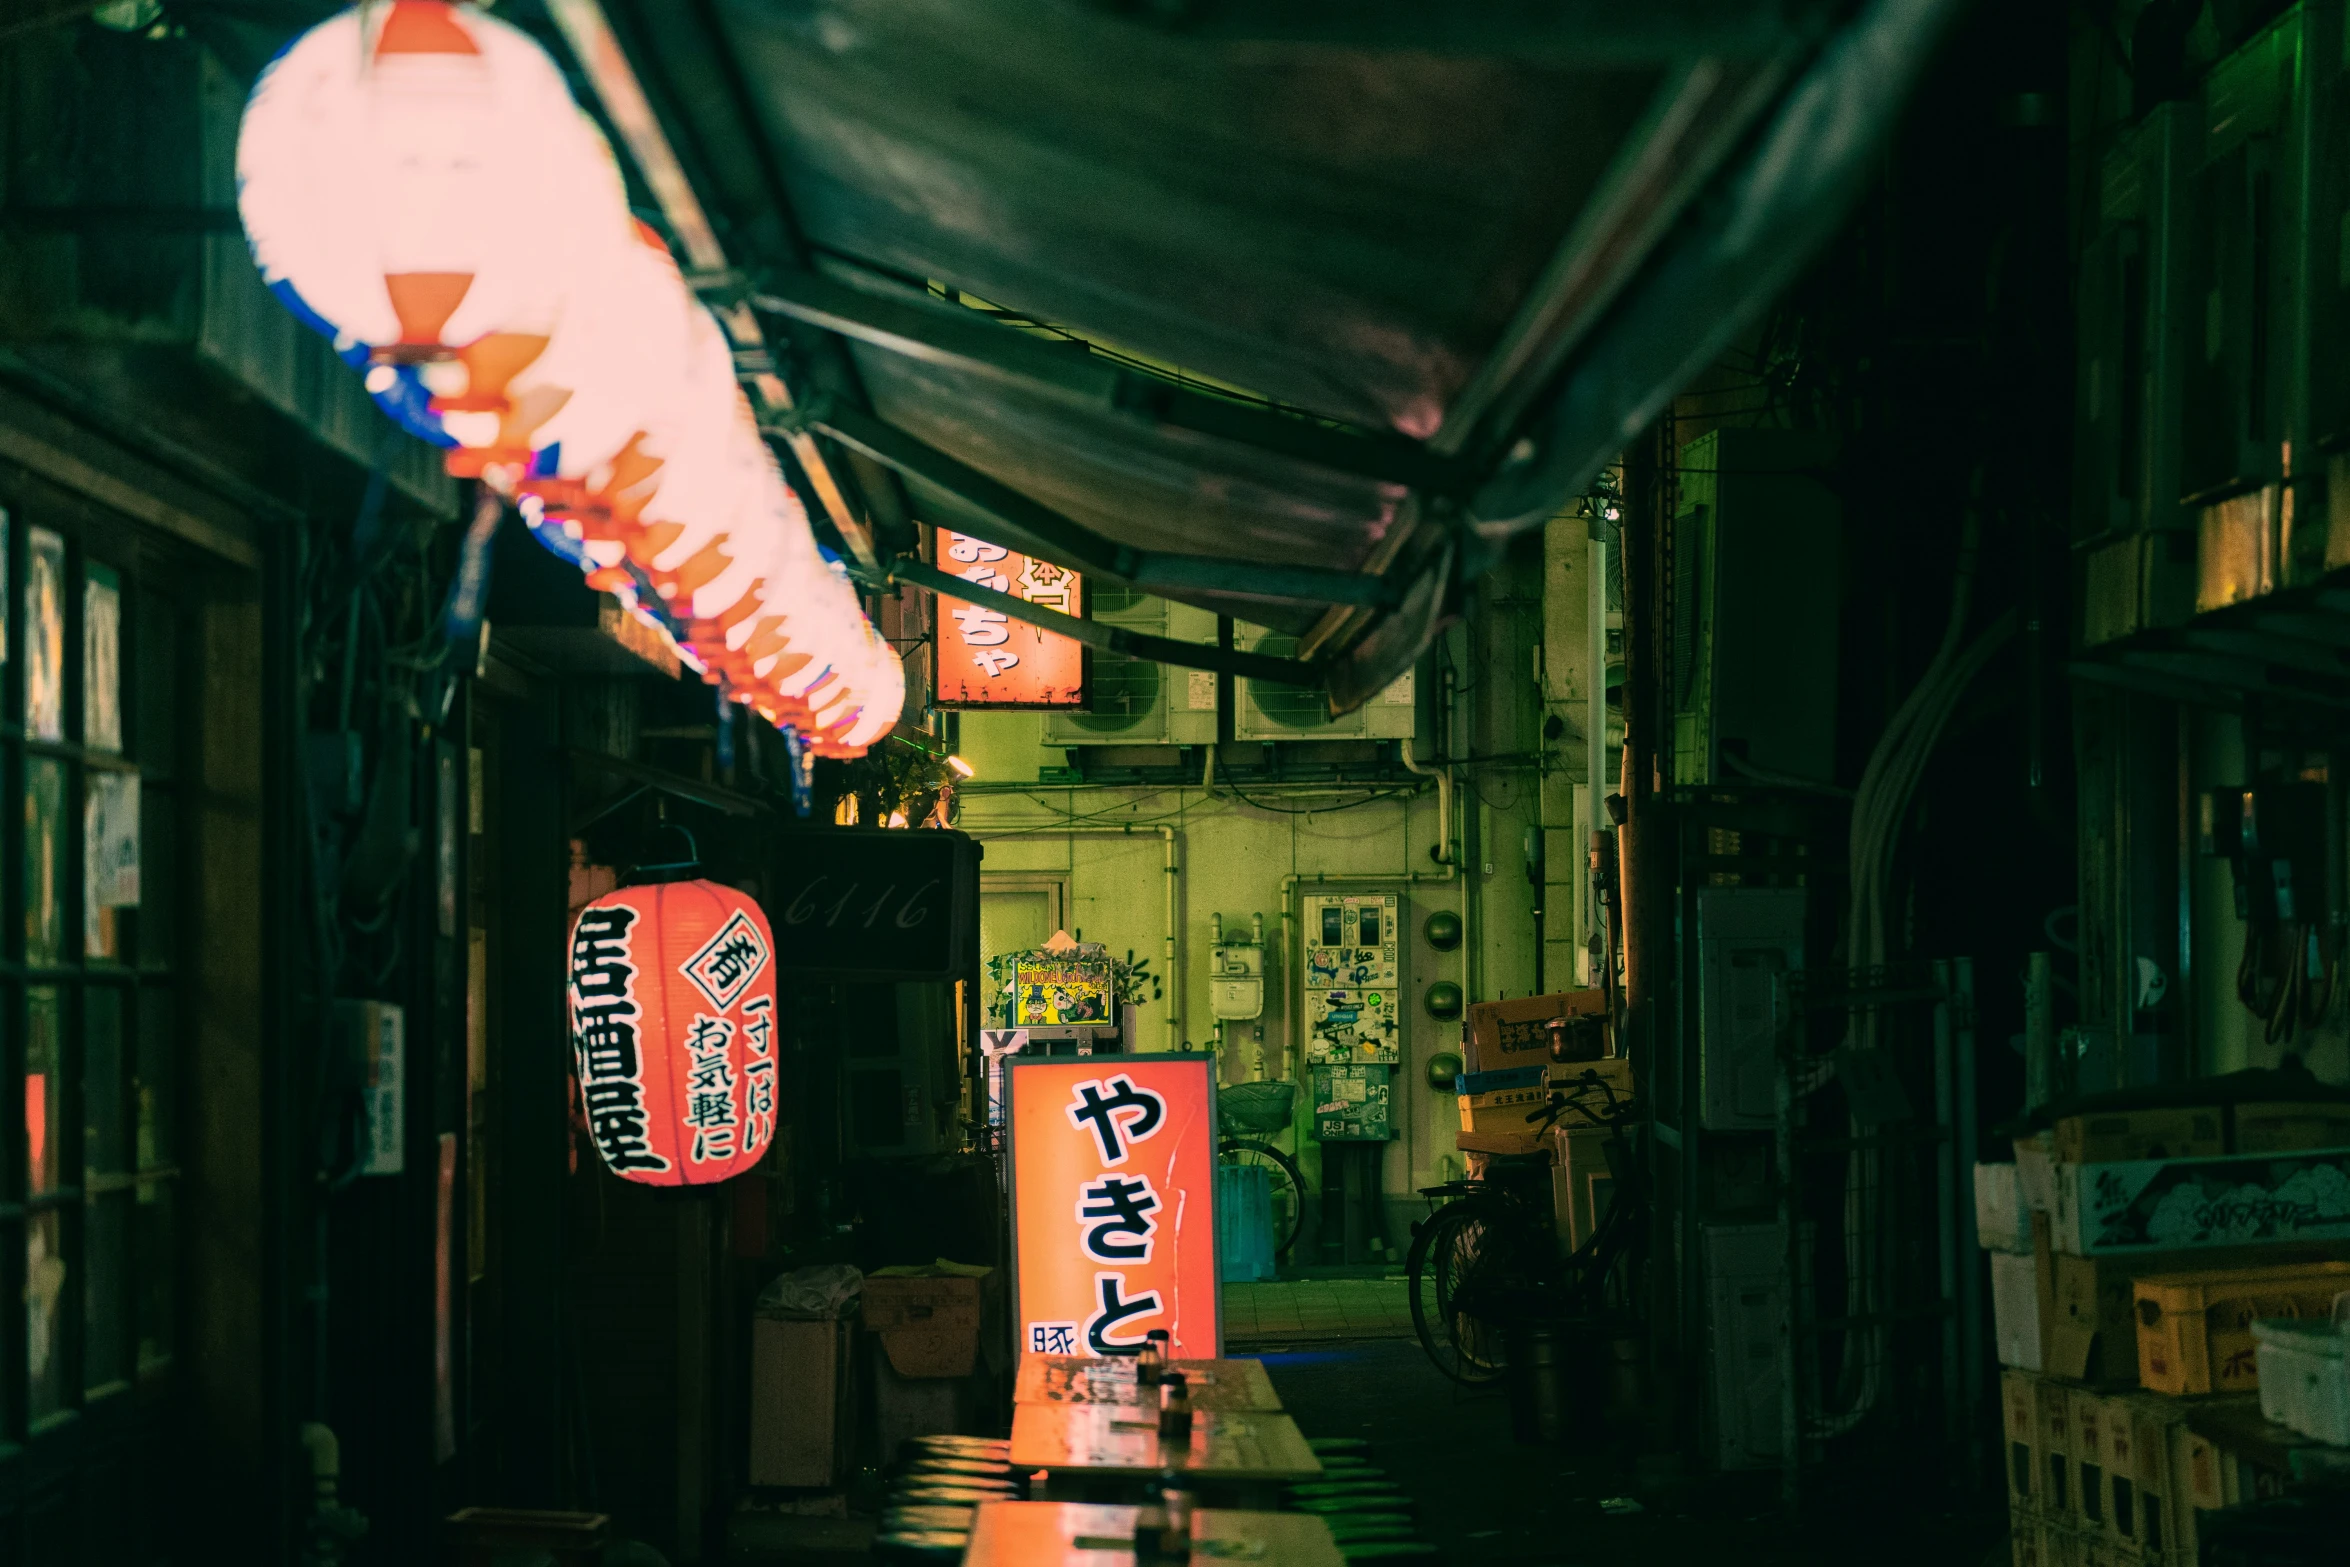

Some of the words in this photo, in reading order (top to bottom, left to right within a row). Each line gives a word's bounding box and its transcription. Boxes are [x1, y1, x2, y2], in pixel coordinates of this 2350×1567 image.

[783, 874, 941, 929] 6116
[686, 1014, 738, 1162] お気軽に
[1326, 1121, 1341, 1130] JS
[1067, 1074, 1166, 1355] やきと
[1028, 1321, 1077, 1355] 豚
